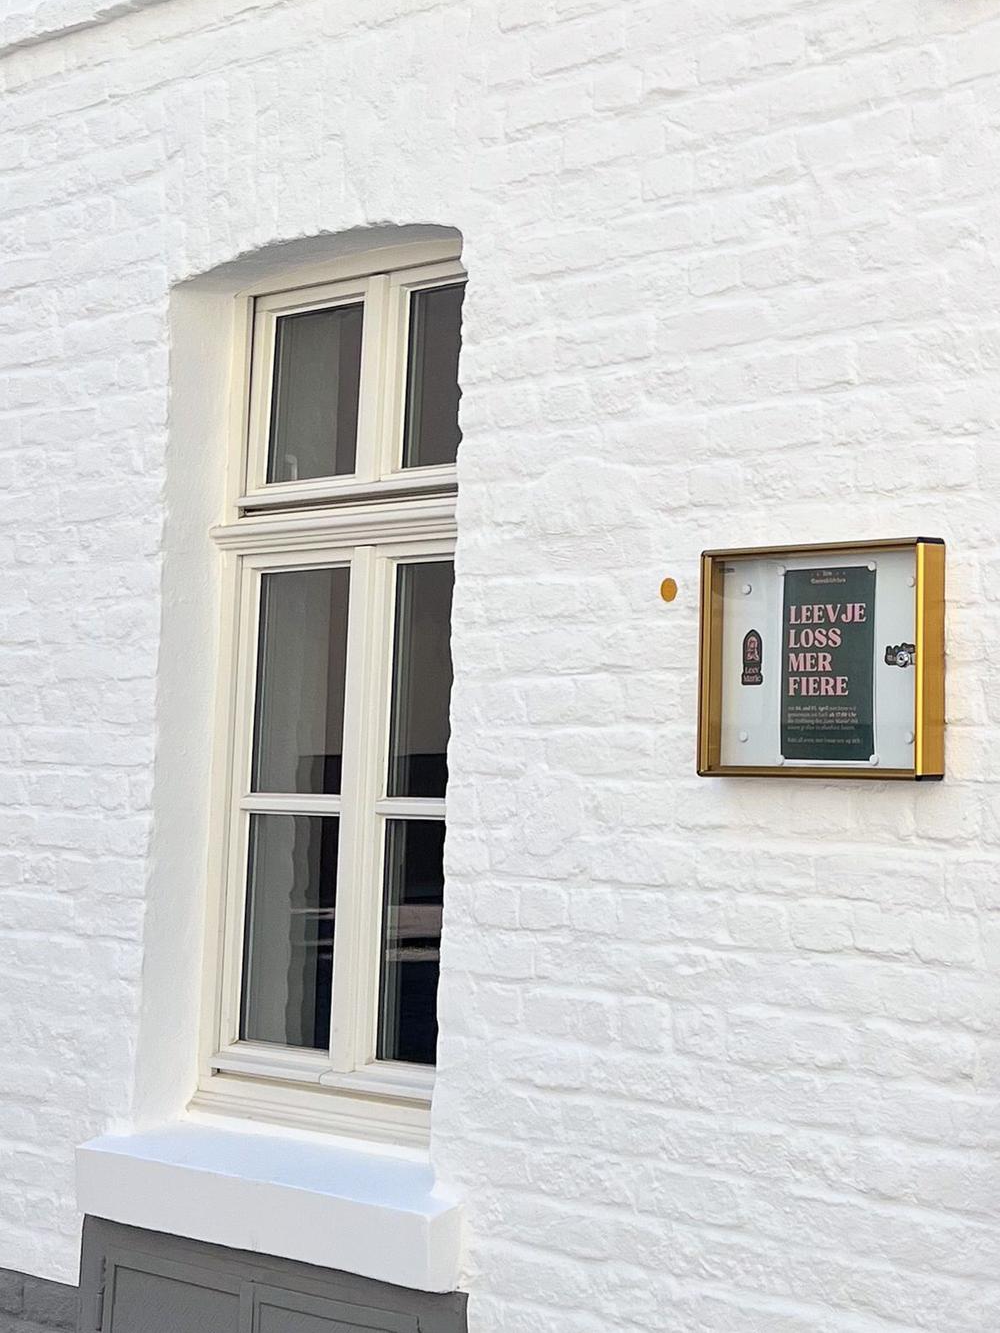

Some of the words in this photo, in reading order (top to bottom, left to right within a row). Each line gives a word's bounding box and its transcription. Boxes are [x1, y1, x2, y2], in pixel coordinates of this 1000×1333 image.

[788, 628, 842, 648] LOSS
[788, 652, 833, 672] MER
[788, 676, 849, 696] FIERE
